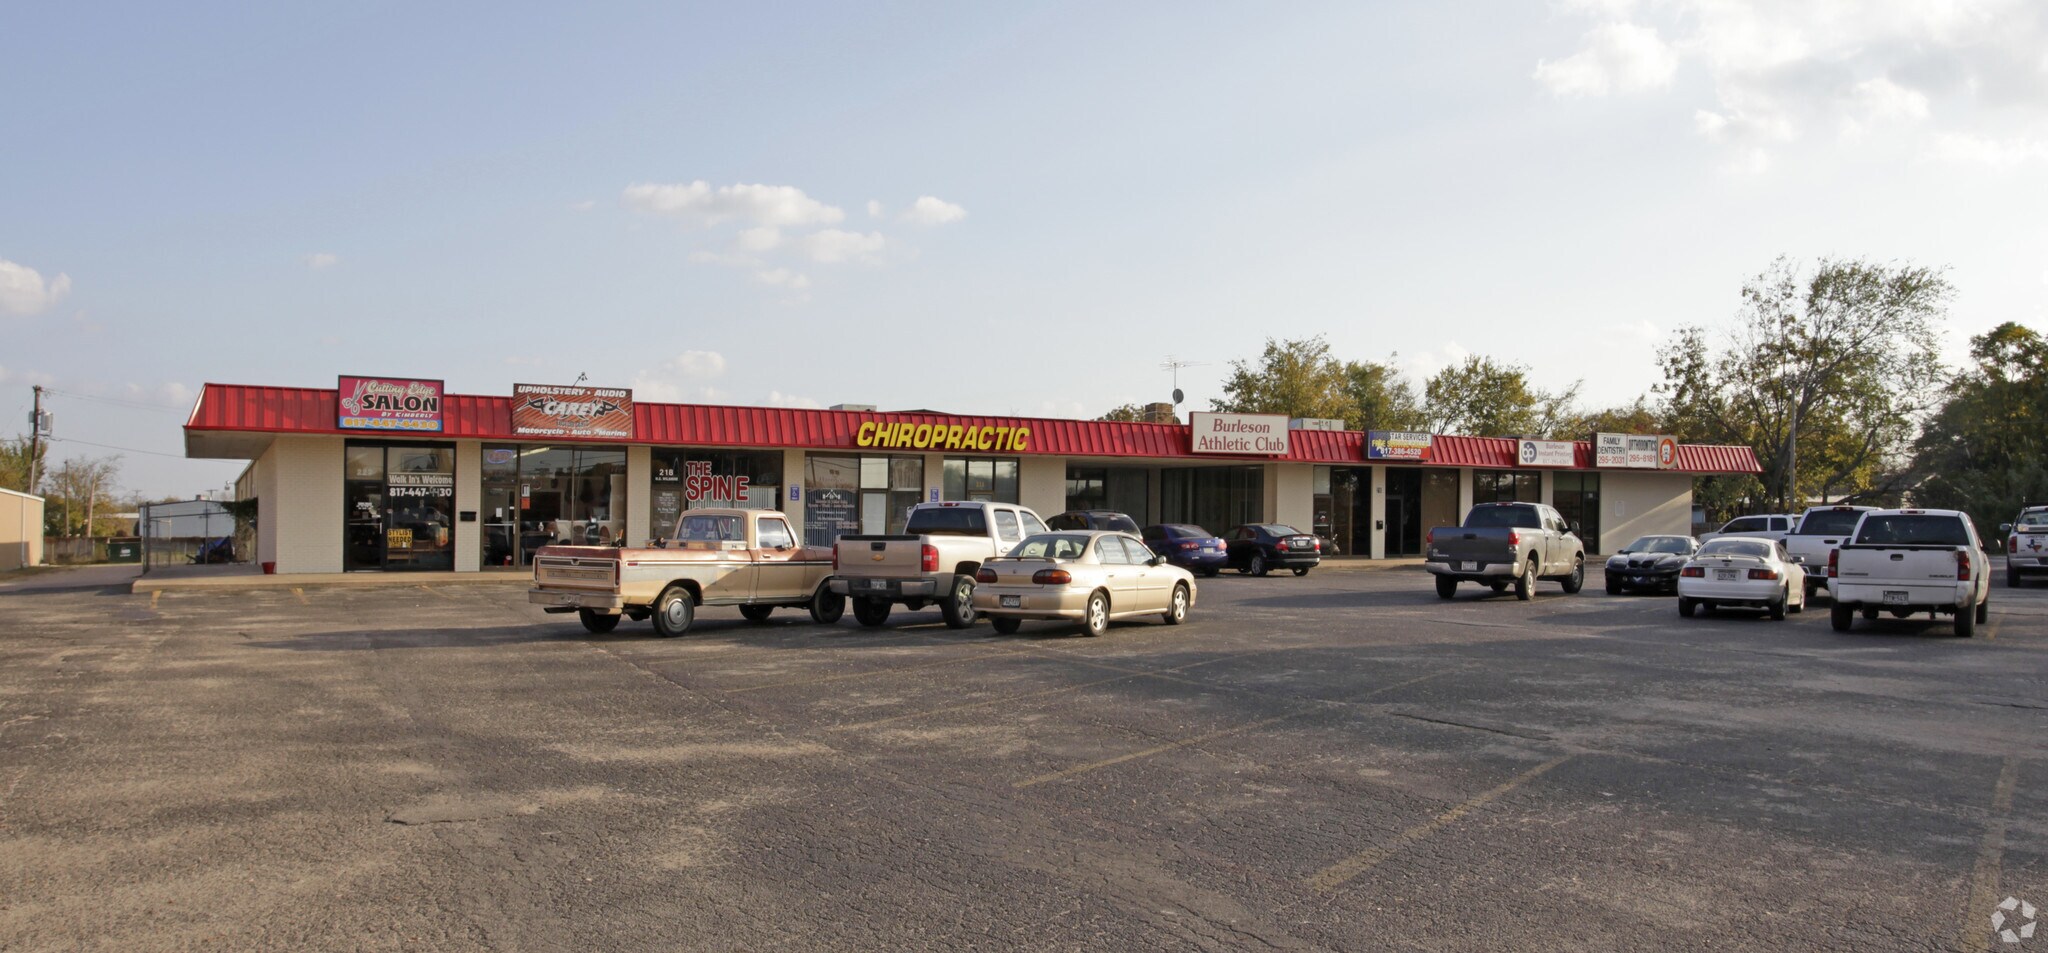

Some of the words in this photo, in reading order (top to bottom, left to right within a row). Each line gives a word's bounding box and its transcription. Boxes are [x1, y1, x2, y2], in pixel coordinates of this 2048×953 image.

[367, 380, 406, 399] Cutting
[408, 382, 435, 400] Edge
[518, 385, 585, 396] UPHOLSTERY
[594, 389, 626, 397] AUDIO
[362, 395, 438, 412] SALON
[543, 401, 602, 417] CAREY
[343, 417, 438, 429] 817-447-4430
[1213, 418, 1270, 433] Burleson
[857, 421, 1030, 450] CHIROPRACTIC
[1403, 433, 1428, 441] SERVICES
[1603, 437, 1620, 445] FAMILY
[1198, 435, 1250, 451] Athletic
[1255, 436, 1284, 451] Club
[1629, 439, 1657, 451] ORTHODONTICS
[1555, 450, 1573, 458] Printing
[1598, 456, 1625, 464] 295-2031
[1629, 454, 1656, 462] 295-8181
[659, 468, 673, 476] 218
[686, 461, 712, 477] THE
[389, 475, 406, 483] Walk
[422, 475, 453, 484] Welcome
[686, 476, 749, 501] SPINE
